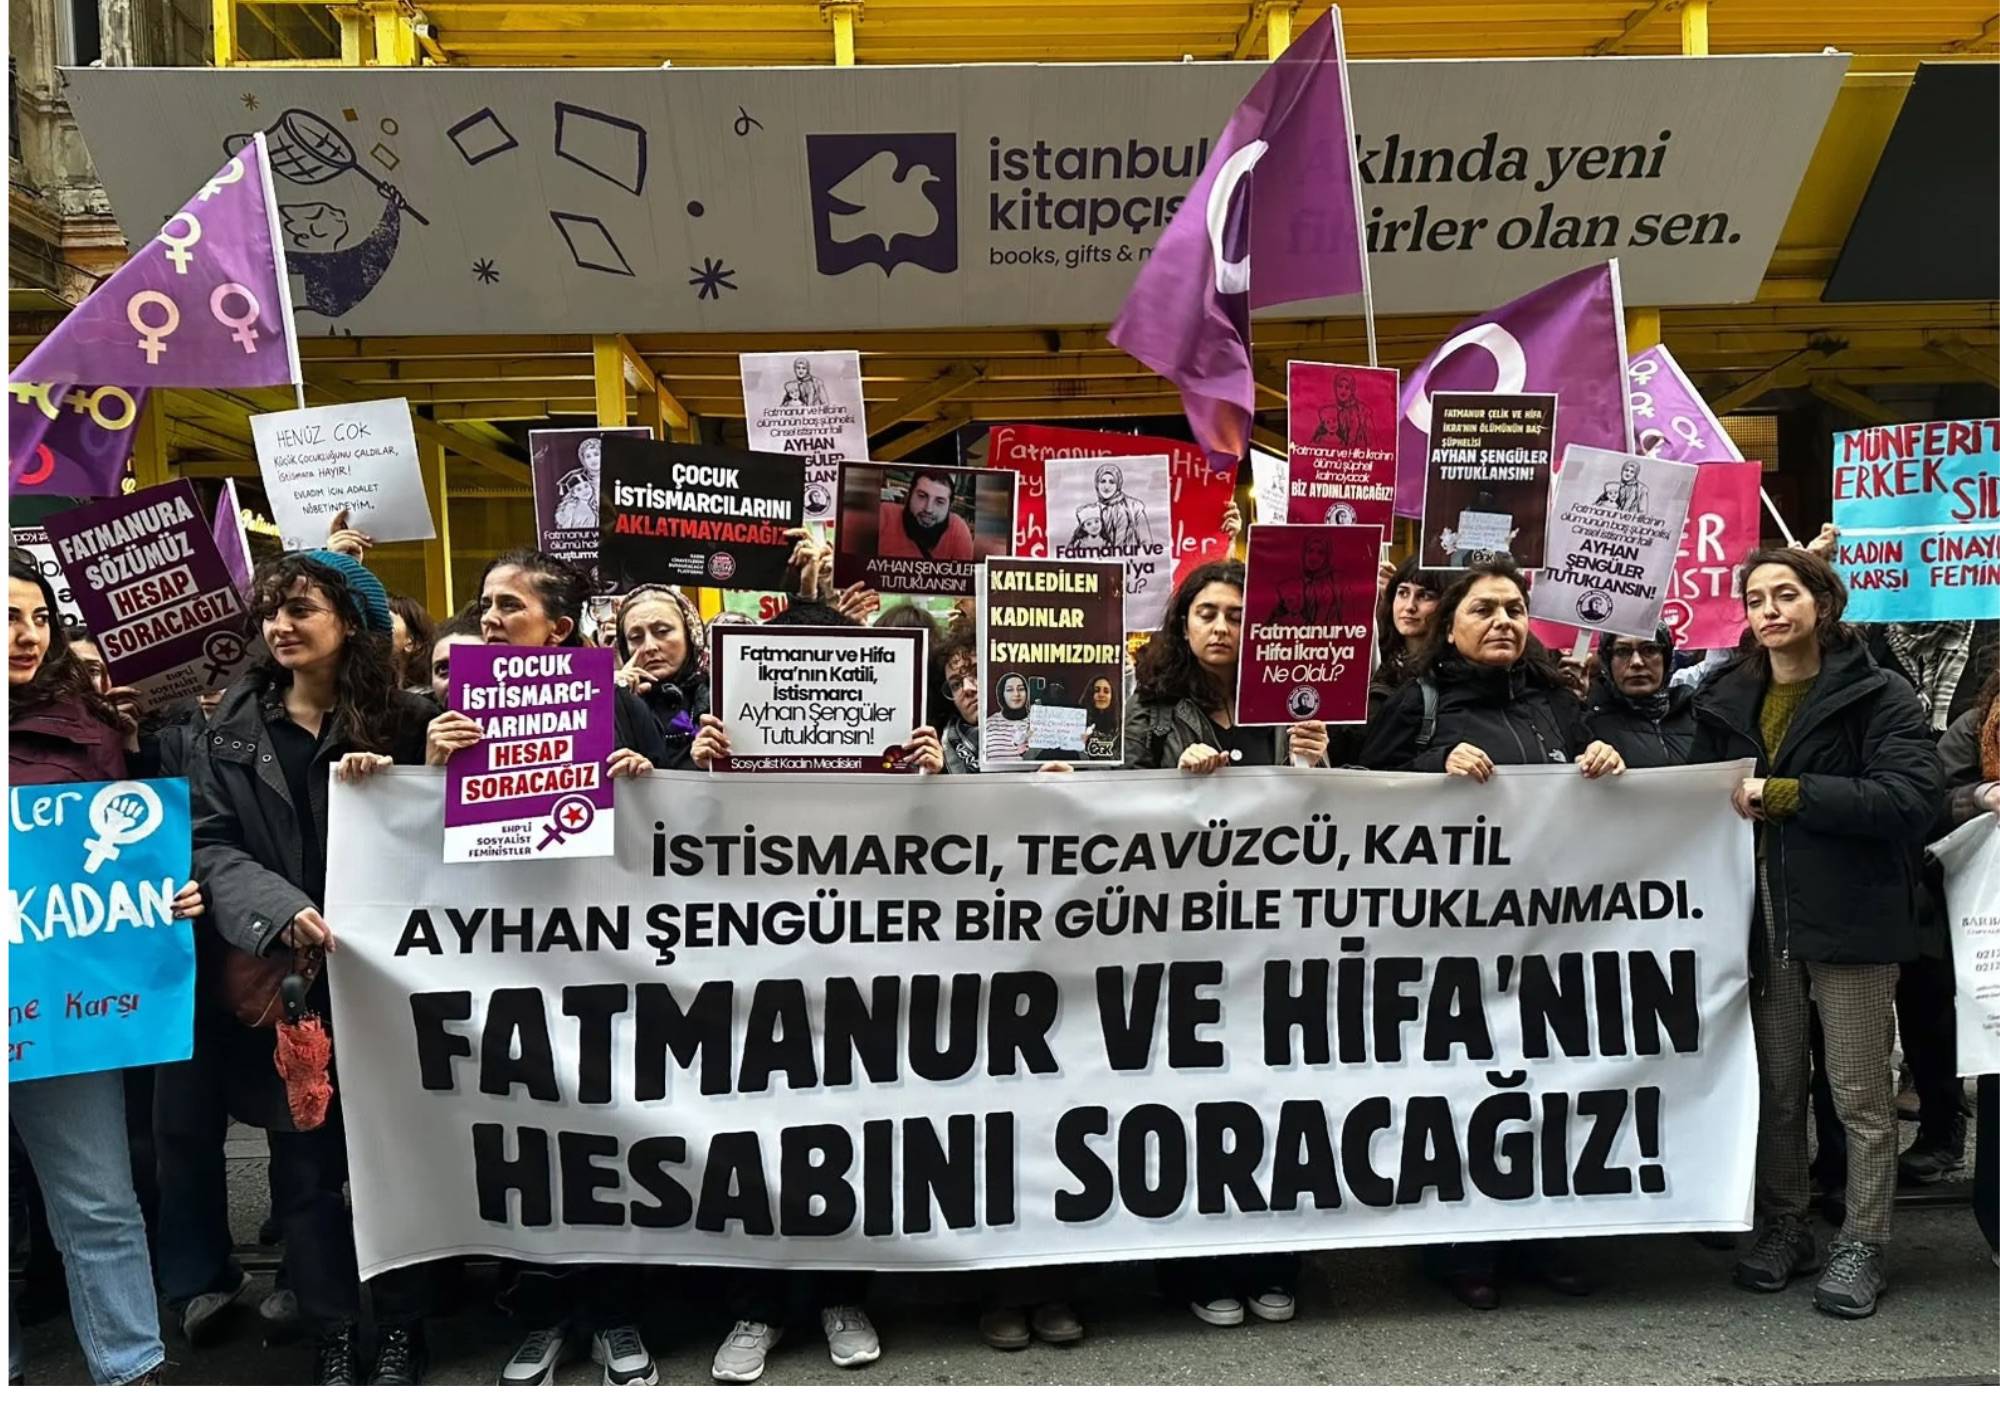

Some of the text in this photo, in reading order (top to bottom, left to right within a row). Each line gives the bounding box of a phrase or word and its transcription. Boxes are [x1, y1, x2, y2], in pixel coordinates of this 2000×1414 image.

[989, 136, 1209, 181] istanbul
[1354, 130, 1672, 191] klında yeni
[989, 187, 1187, 236] kitapçıs
[1366, 203, 1741, 253] irler olan sen.
[989, 247, 1060, 266] books,
[1066, 244, 1112, 268] gifts
[1117, 244, 1133, 262] &
[1444, 409, 1485, 418] FATMANUR
[1512, 410, 1523, 419] VE
[784, 437, 835, 452] AYHAN
[1431, 447, 1548, 466] AYHAN ŞENGÜLER
[805, 451, 845, 467] GÜLE
[672, 462, 740, 490] ÇOCUK
[1440, 466, 1535, 481] TUTUKLANSIN!
[1834, 457, 1948, 500] ERKEK
[346, 483, 379, 494] ADALET
[614, 480, 792, 520] İSTİSMARCILARINI
[1291, 478, 1394, 501] BİZ AYDINLATACAĞIZ!
[58, 495, 195, 565] FATMANURA
[615, 513, 788, 546] AKLATMAYACAĞIZ
[85, 531, 195, 590] SÖZÜMÜZ
[1056, 541, 1142, 559] Fatmanur
[1142, 542, 1163, 555] ve
[1579, 539, 1639, 562] AYHAN
[1839, 531, 1999, 566] KADIN CİNAY
[866, 559, 914, 574] AYHAN
[1566, 553, 1644, 580] ŞENGÜLER
[881, 575, 966, 592] TUTUKLANSIN!
[990, 569, 1098, 593] KATLEDİLEN
[1546, 566, 1657, 600] TUTUKLANSIN!
[1851, 568, 1909, 592] KARŞI
[114, 570, 189, 617] HESAP
[104, 591, 235, 658] SORACAĞIZ
[990, 607, 1084, 628] KADINLAR
[1250, 623, 1367, 640] Fatmanur ve
[740, 646, 895, 663] Fatmanur ve Hifa
[990, 639, 1120, 664] İSYANIMIZDIR!
[1256, 640, 1355, 665] Hifa İkra'ya
[493, 653, 573, 682] ÇOCUK
[830, 665, 878, 685] Katili,
[1262, 663, 1345, 683] Ne Oldu?
[463, 680, 600, 710] İSTİSMARCI-
[773, 681, 863, 702] İstismarcı
[738, 702, 896, 729] Ayhan Şengüler
[760, 725, 875, 745] Tutuklansın!
[495, 739, 569, 767] HESAP
[731, 757, 862, 772] Sosyalist Kadın Meclisleri
[466, 763, 595, 801] SORACAĞIZ
[469, 845, 531, 858] FEMİNİSTLER
[476, 833, 531, 845] SOSYALİST
[652, 814, 1510, 881] İSTİSMARCI, TECAVÜZCÜ, KATİL
[394, 879, 1704, 966] AYHAN ŞENGÜLER BİR GÜN BİLE TUTUKLANMADI.
[65, 990, 140, 1020] Karşı
[409, 937, 1700, 1102] FATMANUR VE HİFA'NIN
[472, 1070, 1666, 1237] HESABINI SORACAĞIZ!
